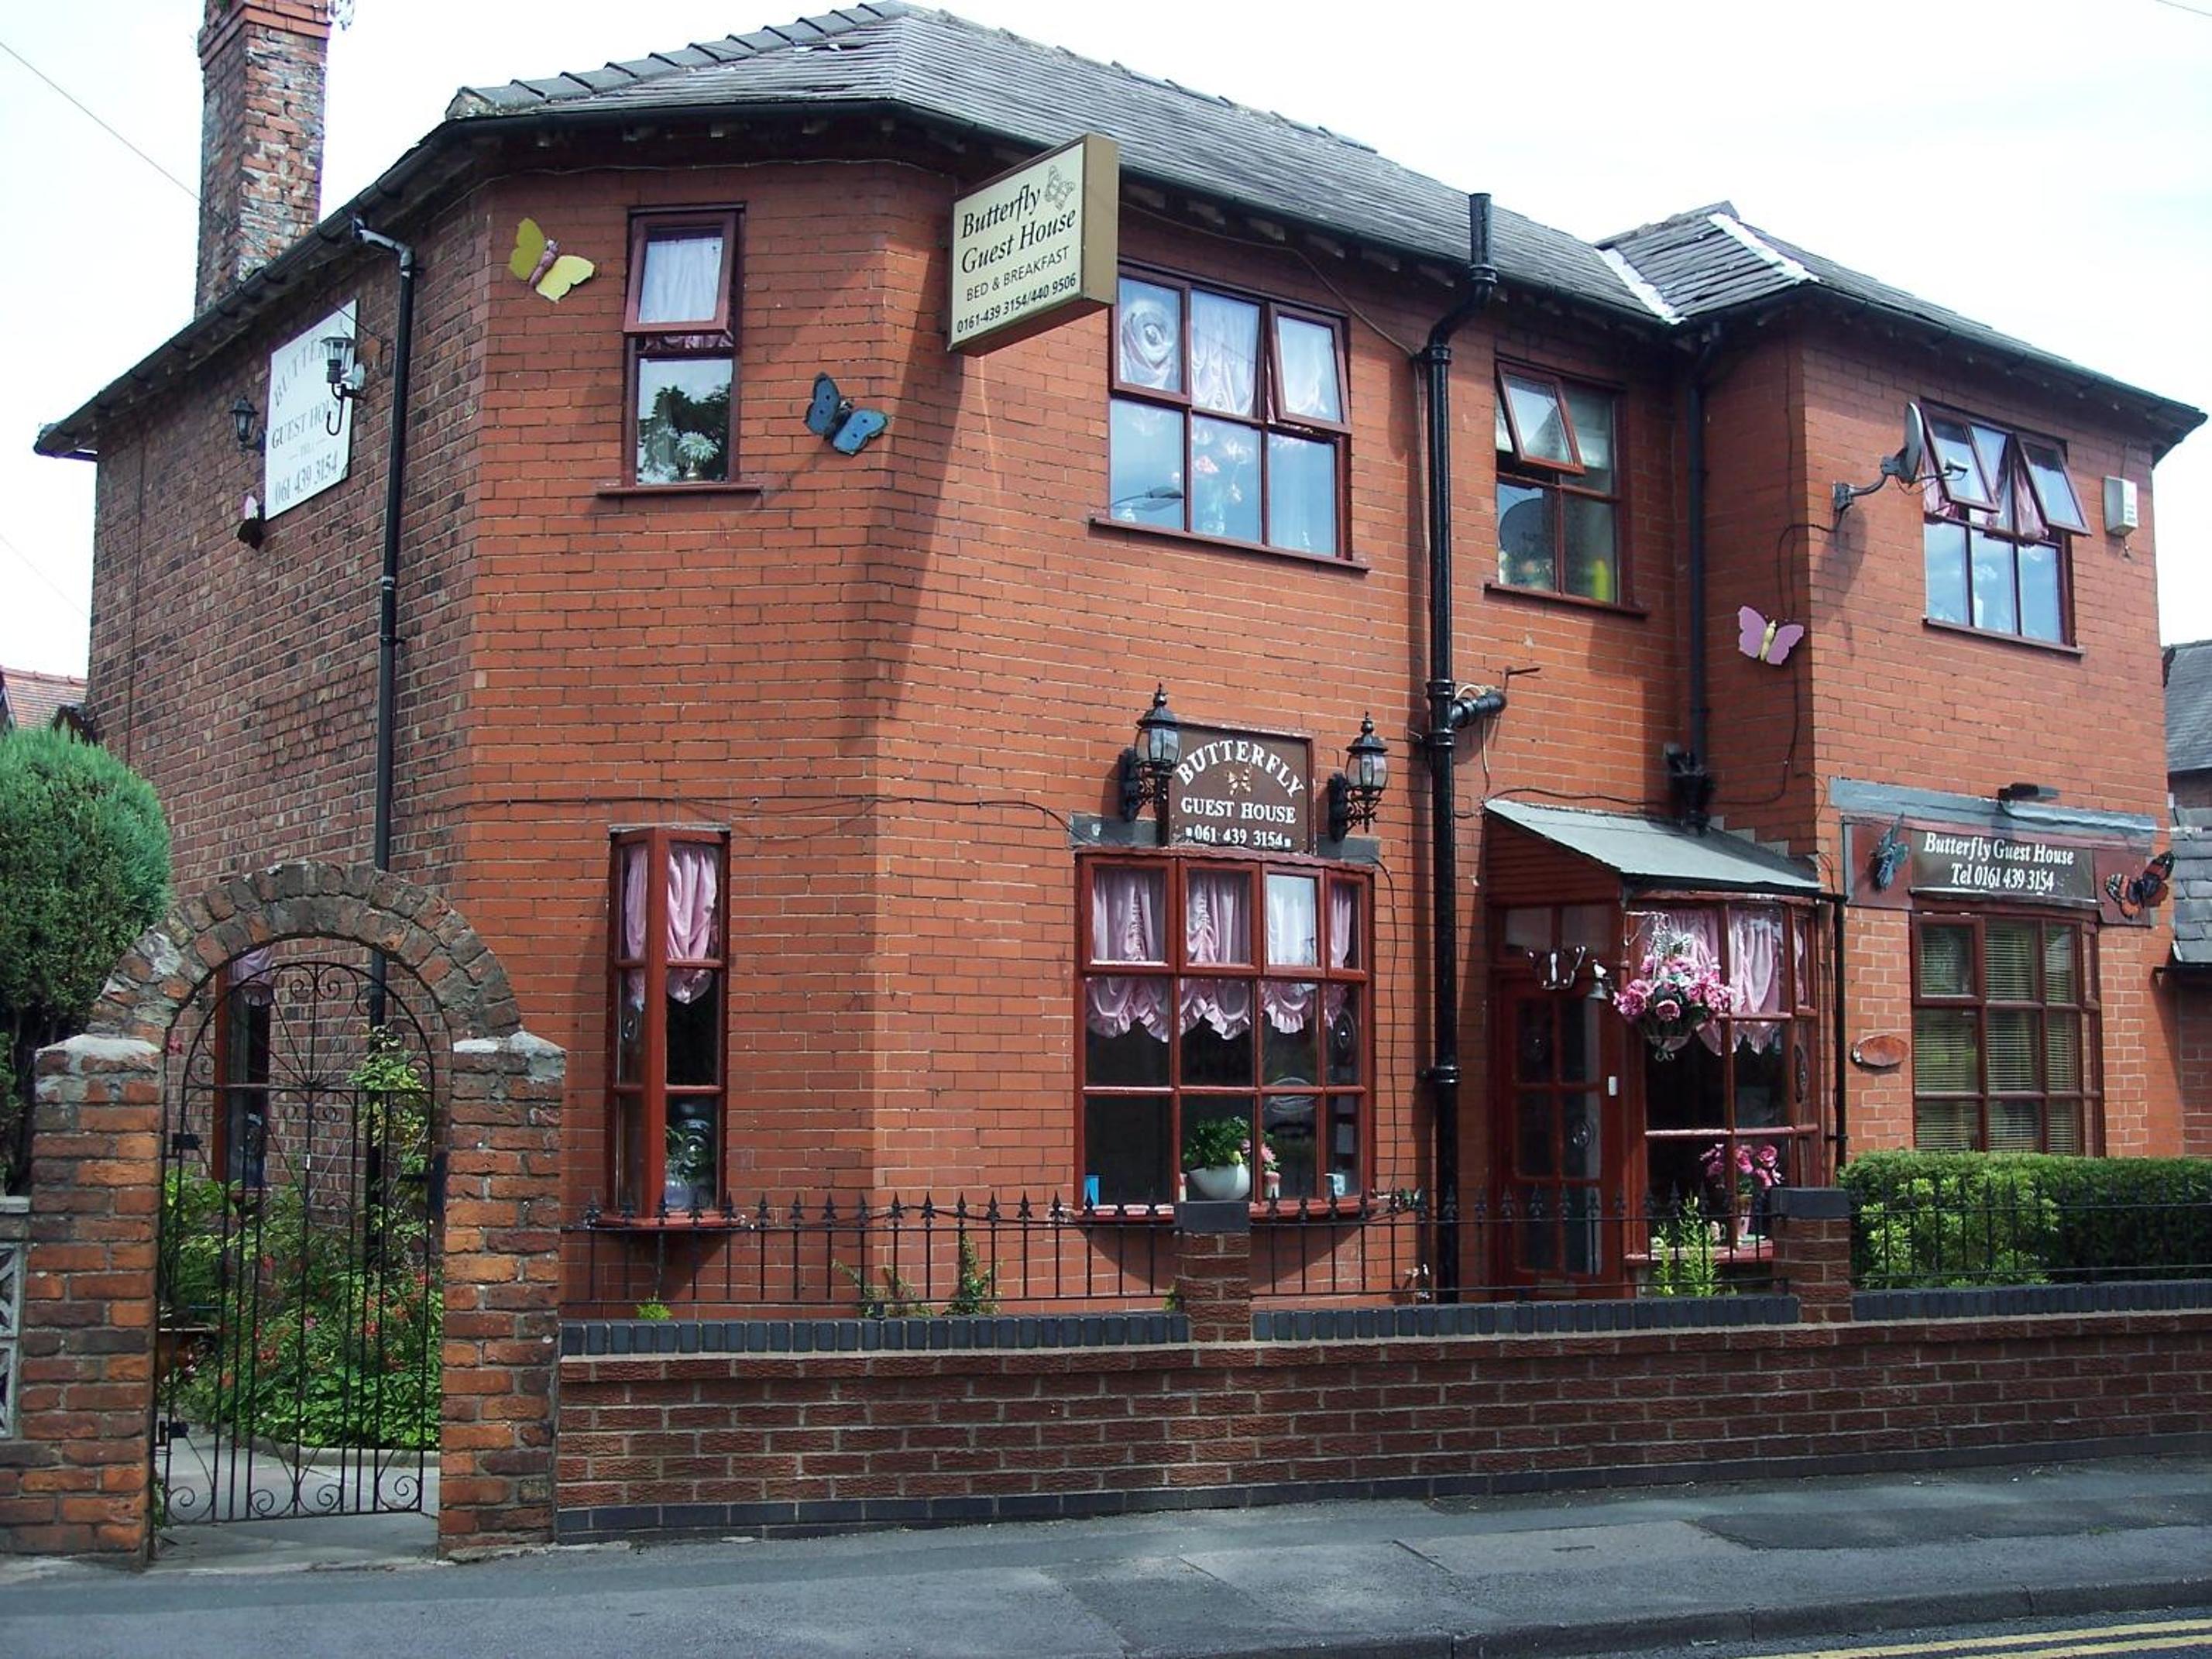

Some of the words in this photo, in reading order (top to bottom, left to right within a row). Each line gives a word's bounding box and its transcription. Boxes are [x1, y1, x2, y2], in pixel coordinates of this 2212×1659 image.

[960, 184, 1040, 239] Butterfly
[961, 233, 1015, 274] Guest
[1018, 209, 1076, 252] House
[967, 282, 989, 302] BED
[991, 276, 1001, 291] &
[1003, 245, 1070, 287] BREAKFAST
[1052, 273, 1077, 296] 9506
[1175, 740, 1305, 798] BUTTERFLY
[1181, 797, 1235, 817] GUEST
[1241, 802, 1297, 823] HOUSE
[1194, 824, 1217, 843] 061
[1223, 828, 1248, 844] 439
[1253, 830, 1283, 847] 3154
[1923, 831, 1991, 862] Butterfly
[1993, 839, 2031, 861] Guest
[2033, 843, 2074, 866] House
[1951, 863, 1972, 885] Tel
[1974, 864, 2001, 888] 0161
